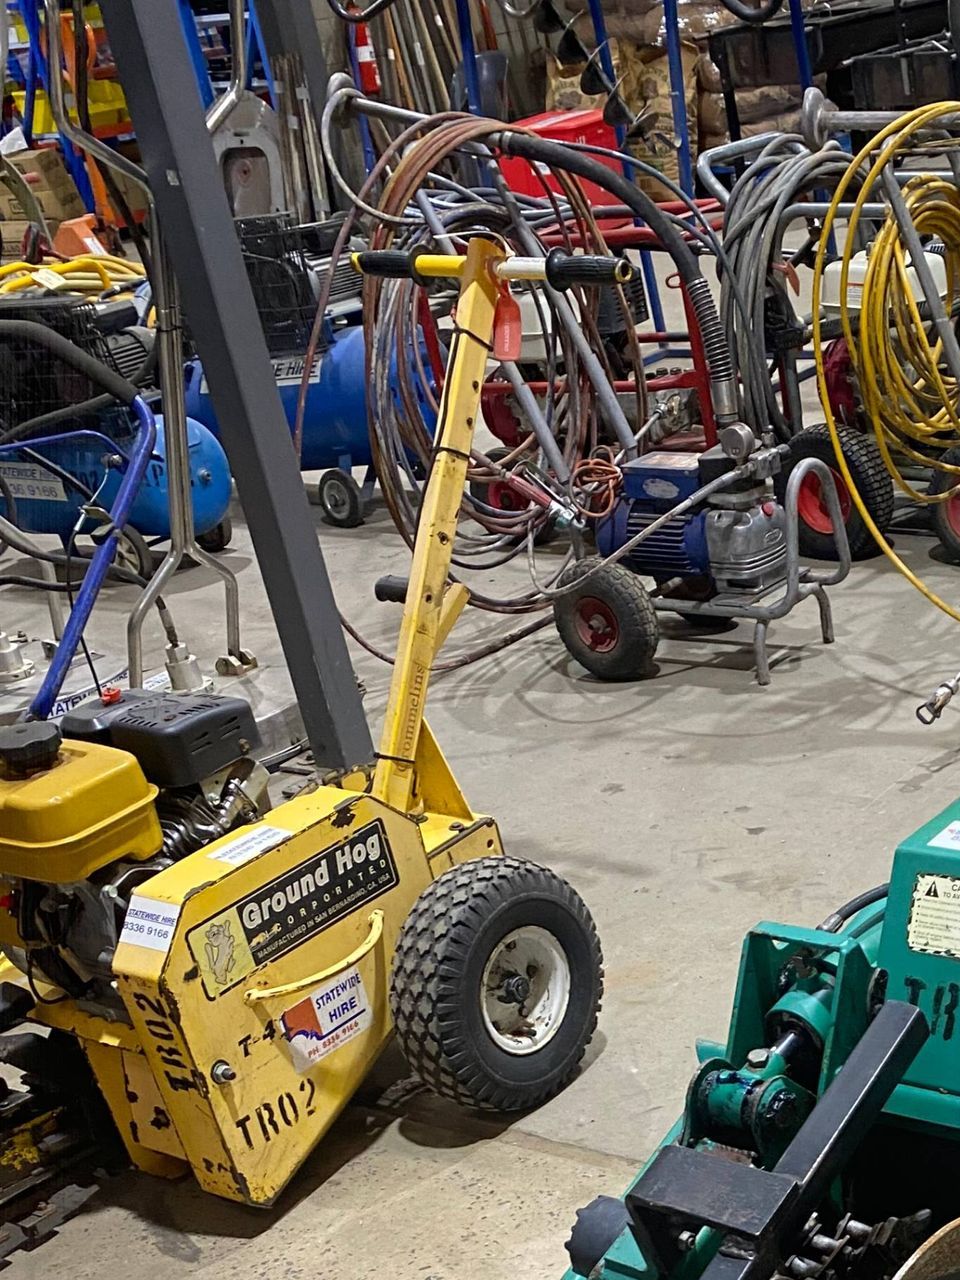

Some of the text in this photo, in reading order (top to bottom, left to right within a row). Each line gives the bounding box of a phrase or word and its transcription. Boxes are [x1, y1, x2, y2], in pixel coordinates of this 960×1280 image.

[242, 833, 381, 929] Ground Hog
[128, 908, 177, 926] STATEWIDE HIRE
[256, 859, 386, 946] CORPORATED
[257, 925, 307, 958] MANUFACTURED
[307, 918, 315, 928] IN
[314, 911, 328, 923] SAN
[378, 872, 391, 884] USA
[123, 921, 169, 939] 8336 9166
[315, 972, 361, 1010] STATEWIDE
[328, 996, 358, 1023] HIRE
[322, 1033, 341, 1049] 8336
